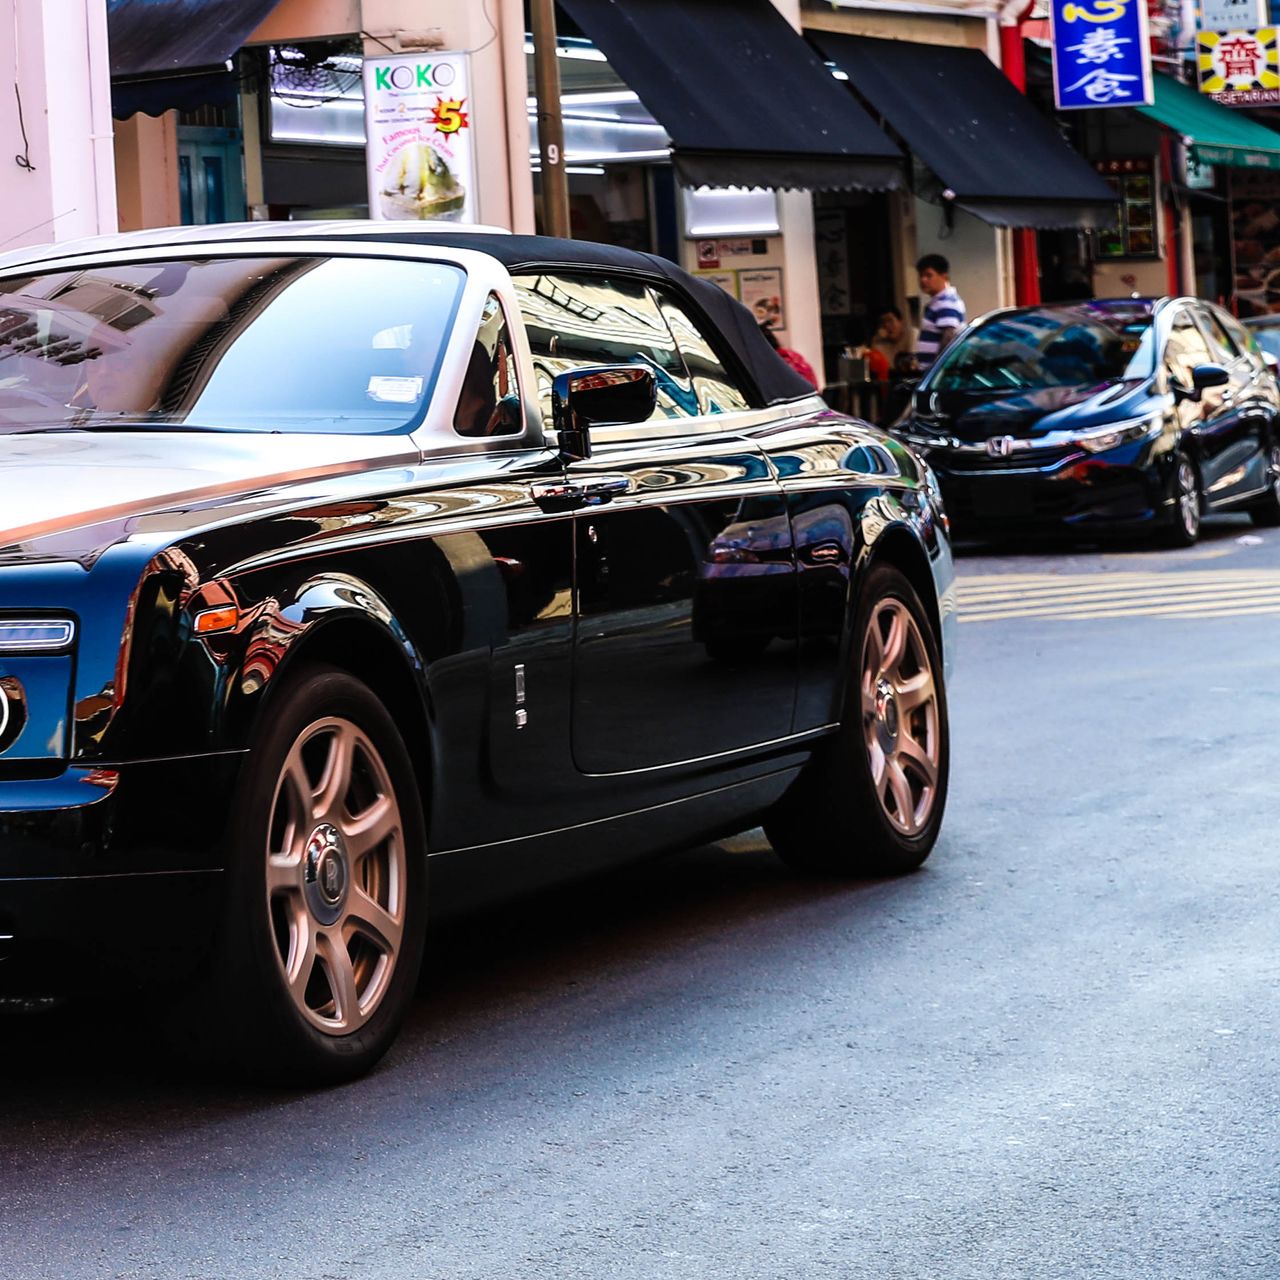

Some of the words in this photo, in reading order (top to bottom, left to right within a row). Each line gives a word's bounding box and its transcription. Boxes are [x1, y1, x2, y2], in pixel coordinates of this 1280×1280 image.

[375, 62, 456, 91] KOKO
[436, 100, 463, 135] 5
[547, 143, 560, 165] 9
